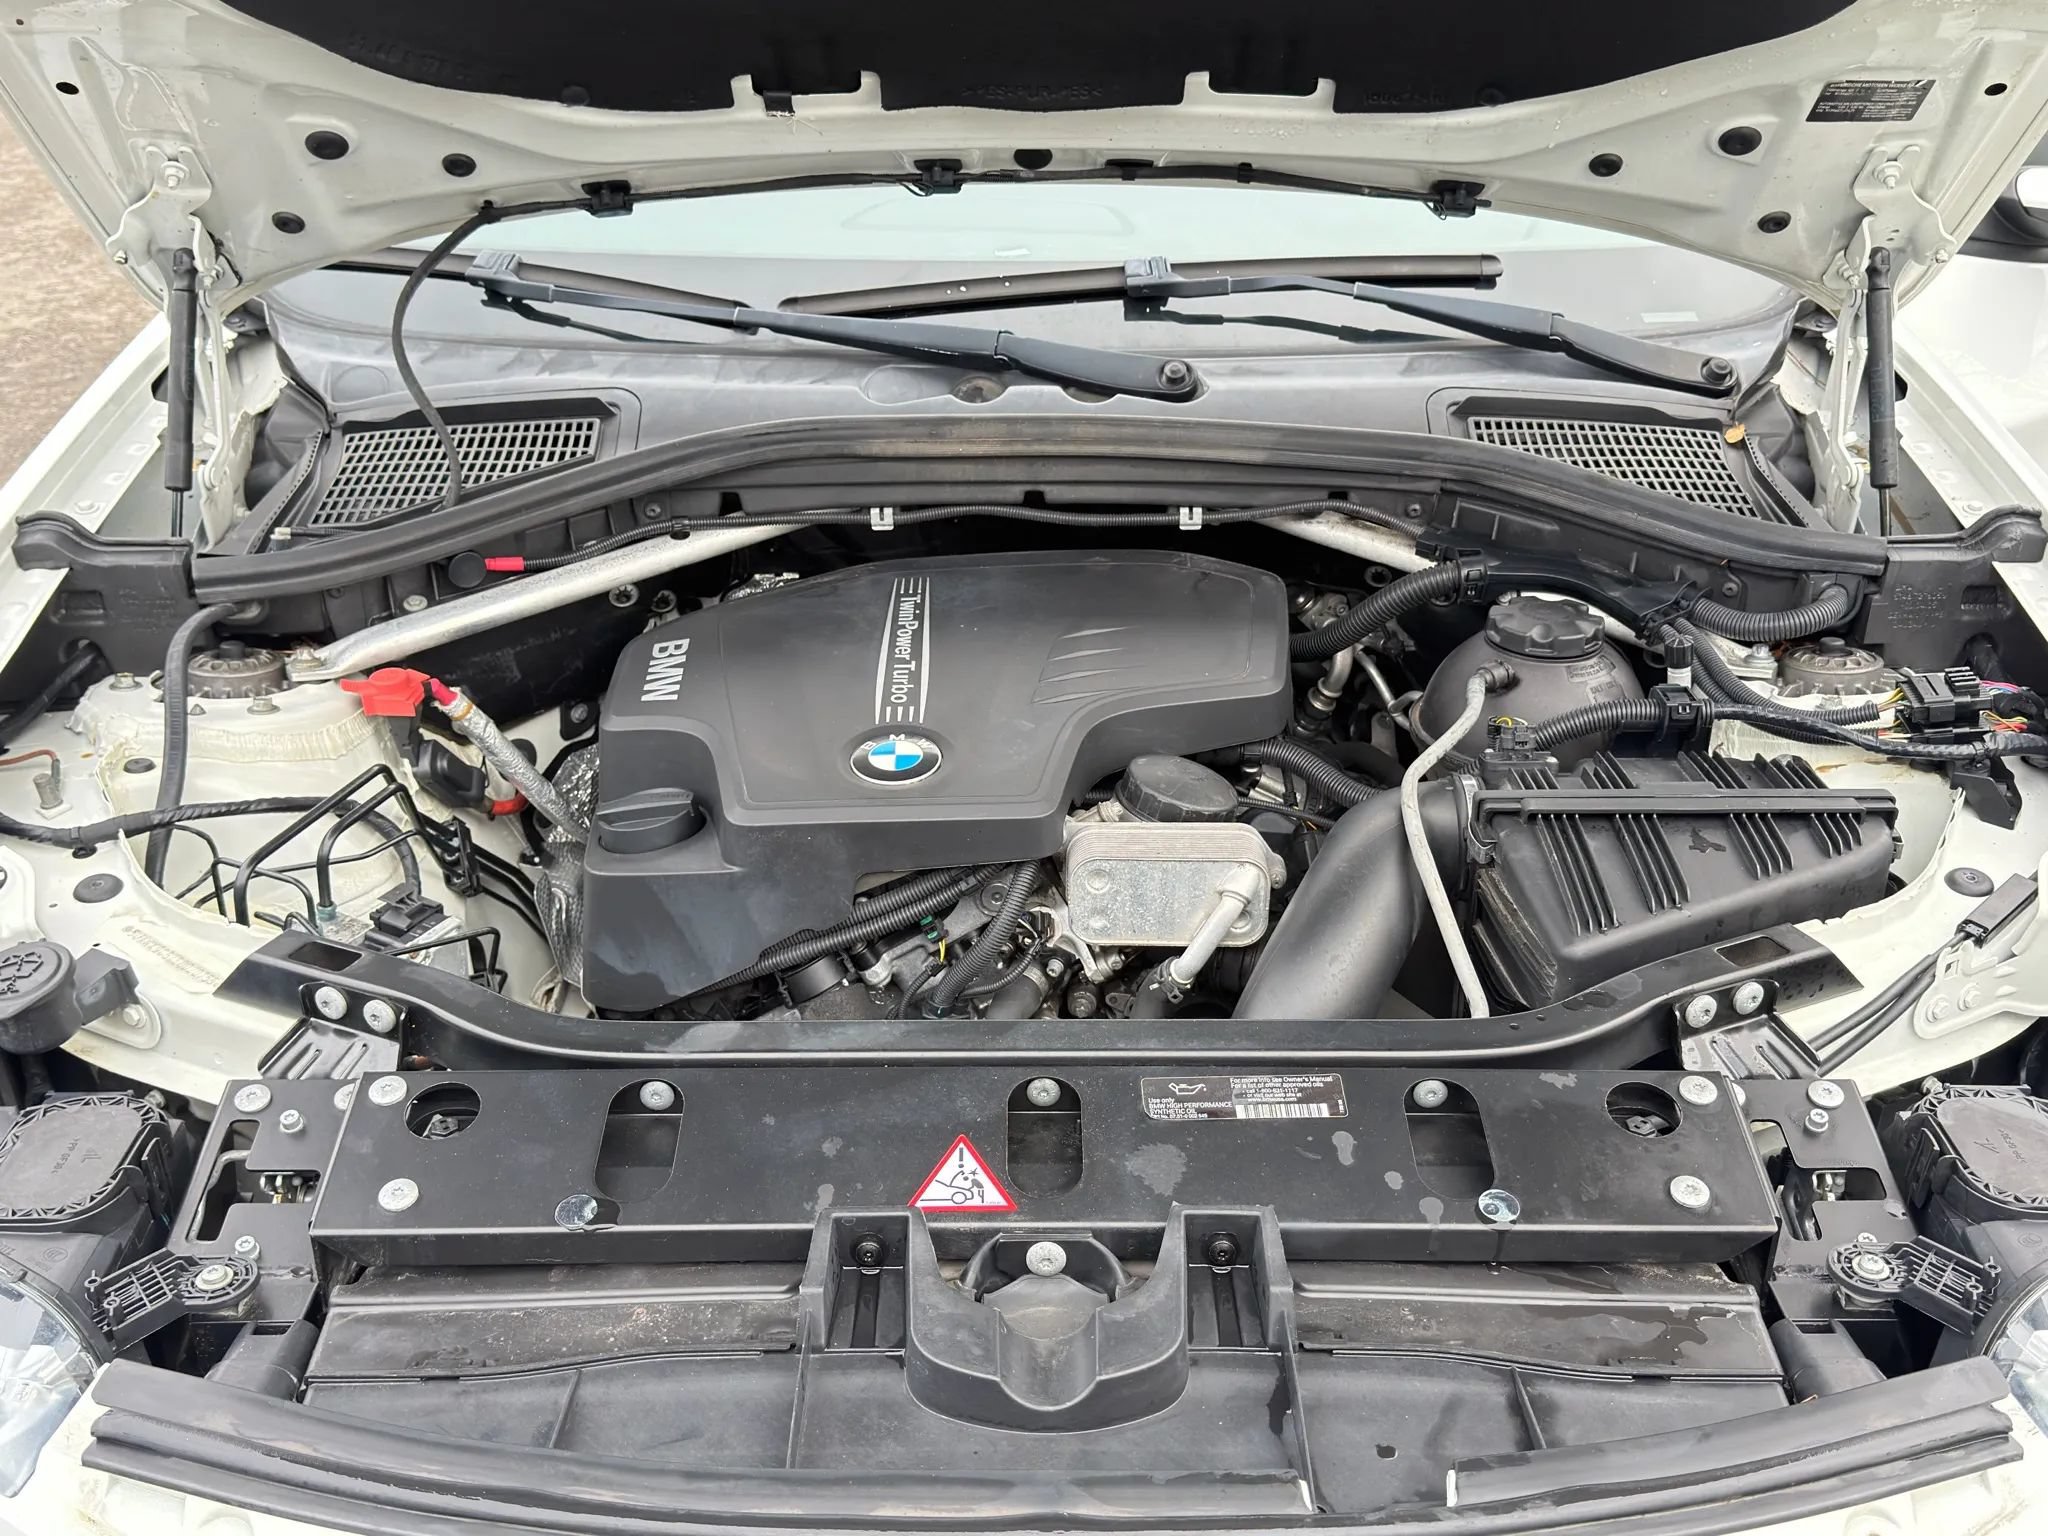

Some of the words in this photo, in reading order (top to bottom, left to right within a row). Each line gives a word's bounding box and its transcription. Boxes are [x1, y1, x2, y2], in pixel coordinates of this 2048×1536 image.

[894, 594, 921, 661] TwinPower
[640, 638, 690, 702] BMW
[890, 660, 916, 703] Turbo
[860, 733, 934, 750] BMW
[1161, 1096, 1175, 1104] only
